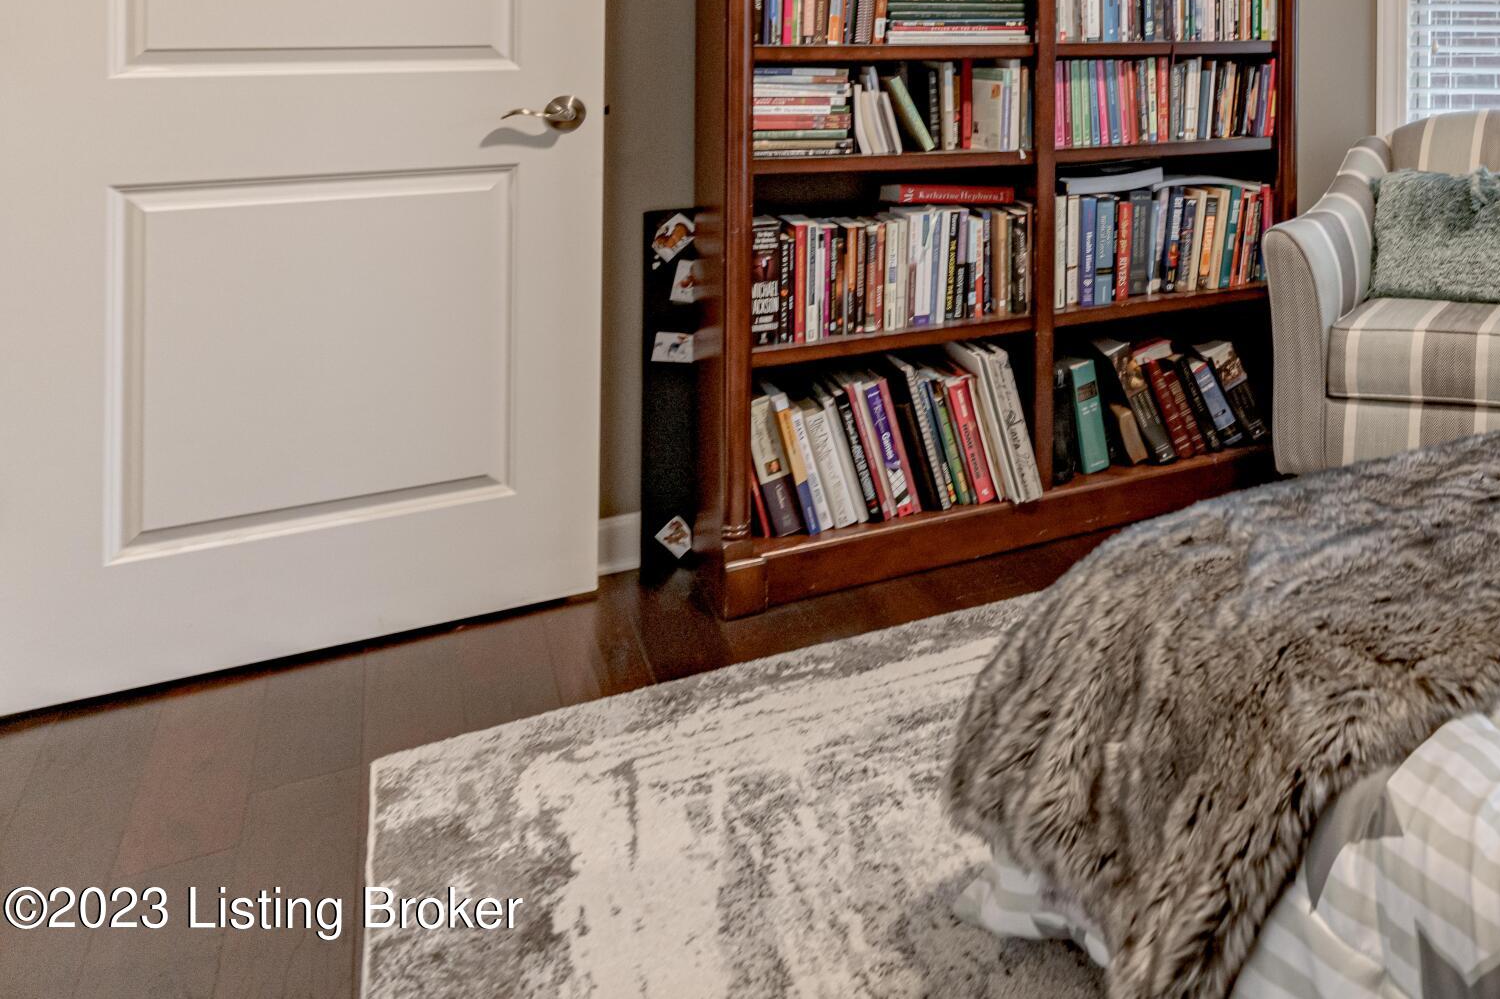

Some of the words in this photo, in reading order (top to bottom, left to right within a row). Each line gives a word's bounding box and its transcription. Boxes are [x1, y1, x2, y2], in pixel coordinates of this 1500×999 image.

[918, 190, 958, 200] Katharine
[960, 190, 998, 201] Hepburn
[781, 243, 789, 285] RADICAL
[1119, 256, 1128, 286] RIVERS
[881, 432, 894, 460] Games
[961, 423, 973, 450] HOME
